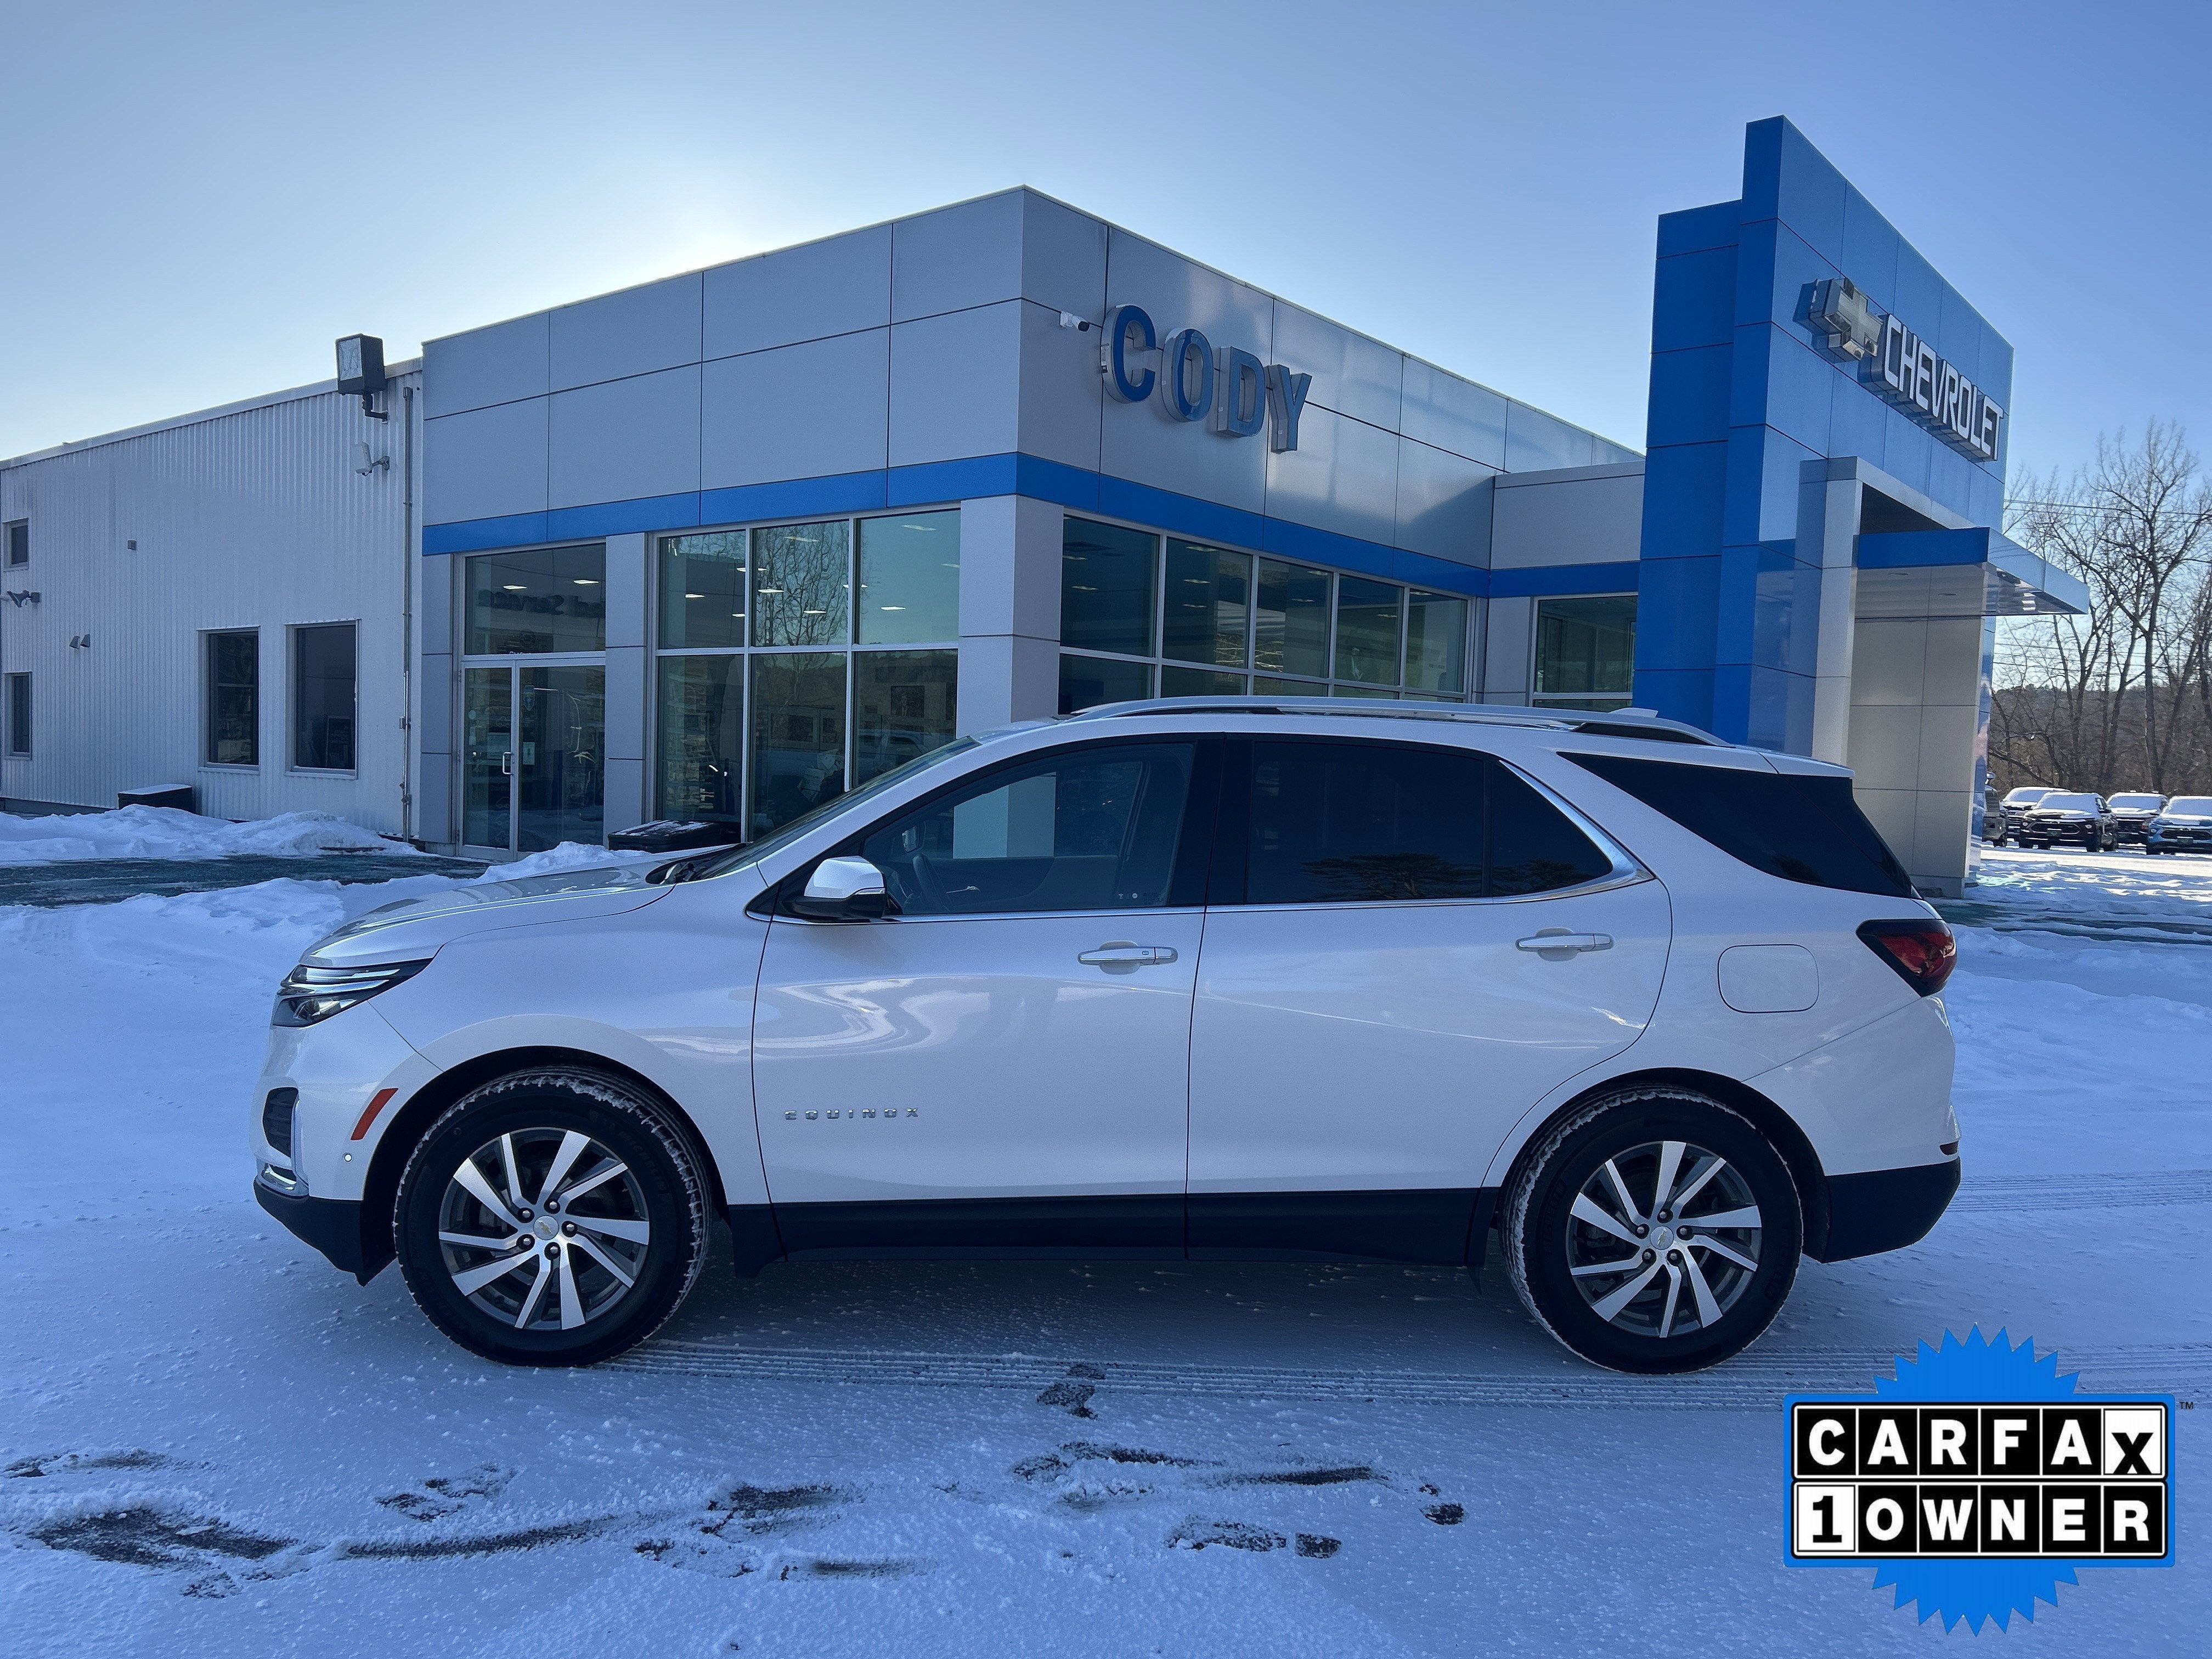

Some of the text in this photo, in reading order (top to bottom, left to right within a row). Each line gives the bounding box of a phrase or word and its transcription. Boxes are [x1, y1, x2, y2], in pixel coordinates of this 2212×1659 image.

[1101, 304, 1312, 454] CODY
[1884, 313, 2005, 461] CHEVROLET
[784, 1108, 918, 1120] EQUINOX
